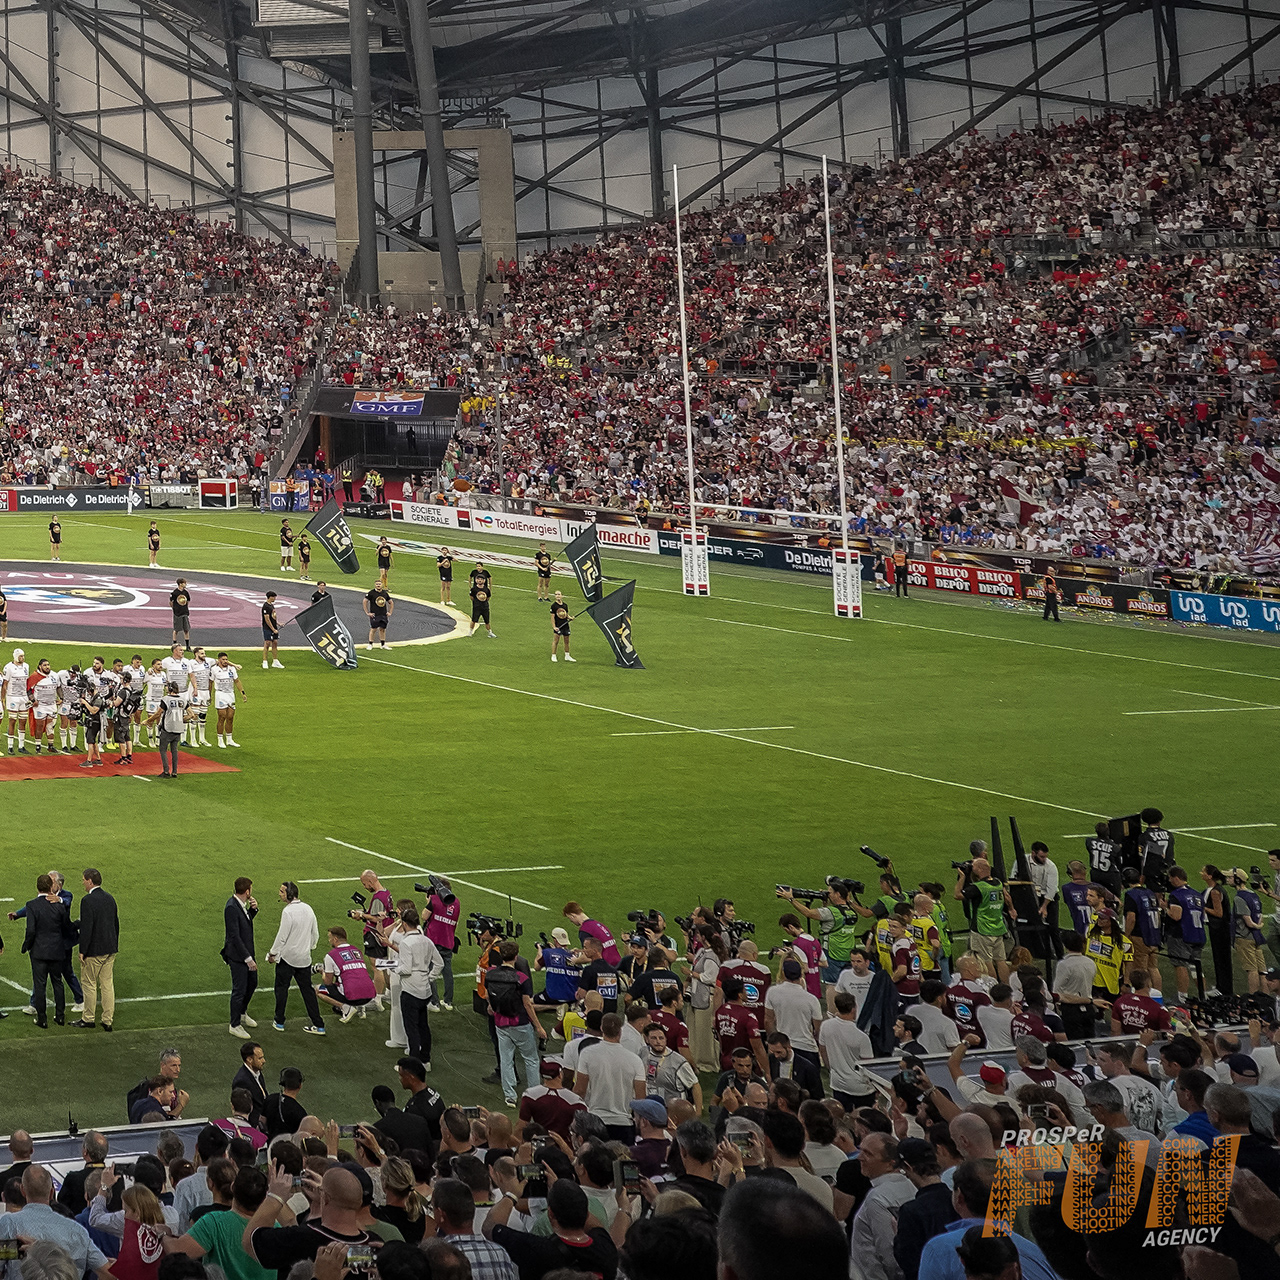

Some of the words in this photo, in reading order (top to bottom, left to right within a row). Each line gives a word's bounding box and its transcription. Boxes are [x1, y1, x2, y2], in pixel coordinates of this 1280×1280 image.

[357, 403, 418, 413] GMF
[20, 495, 28, 504] De
[30, 494, 65, 504] Dietrich
[85, 494, 93, 503] De
[410, 505, 442, 516] SOCIETE
[411, 513, 450, 525] GENERALE
[495, 517, 558, 536] TotalEnergies
[785, 550, 800, 564] De
[801, 553, 833, 568] Dietri
[934, 566, 969, 579] BRICO
[977, 570, 1013, 583] BRICO
[1027, 588, 1062, 600] ANDS
[1077, 595, 1113, 607] ANDROS
[1129, 602, 1167, 613] ANDROS
[1150, 831, 1170, 841] SCUF
[1157, 840, 1169, 855] 7
[1092, 850, 1111, 872] 15
